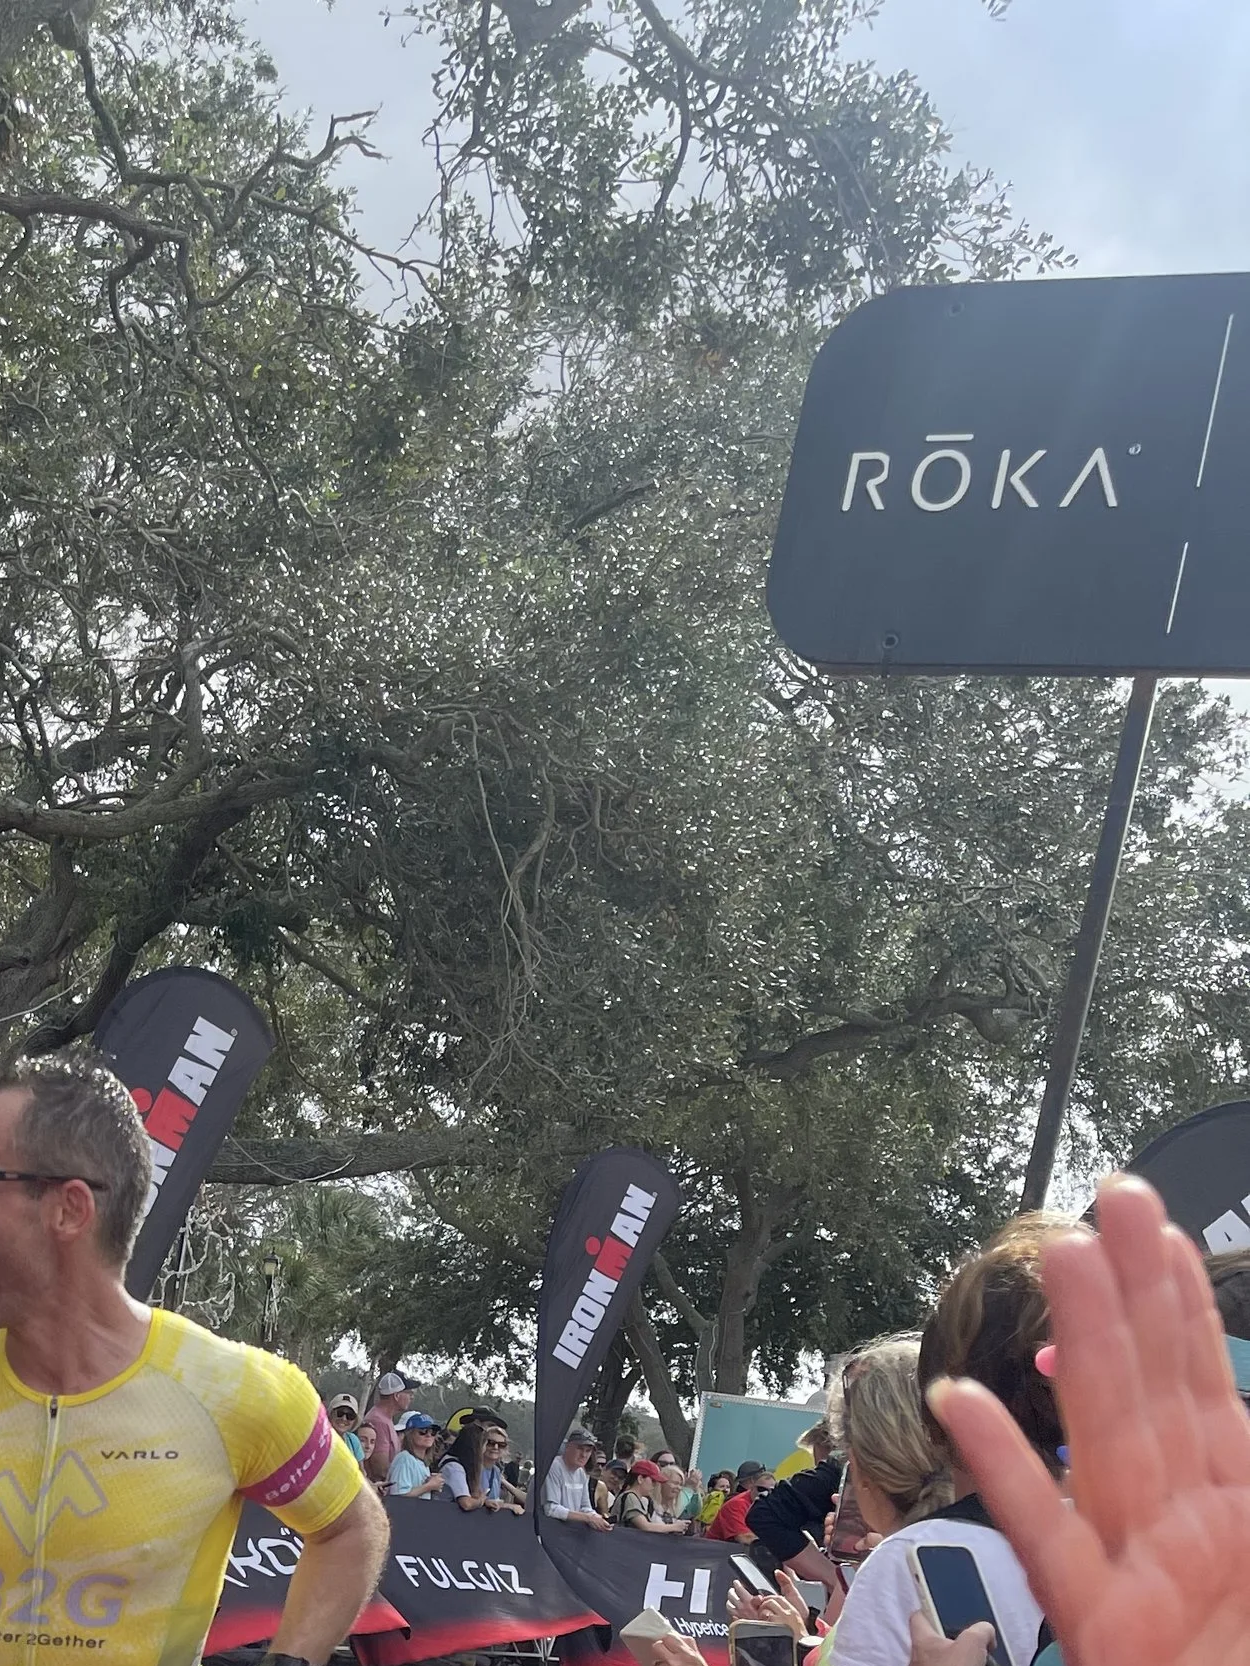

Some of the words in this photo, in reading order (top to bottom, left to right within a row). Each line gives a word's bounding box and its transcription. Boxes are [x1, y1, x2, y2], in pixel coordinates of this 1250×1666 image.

[552, 1183, 657, 1370] IRONMAN
[101, 1450, 179, 1460] VARLO
[395, 1555, 534, 1595] FULGAZ
[674, 1617, 729, 1638] Hyperice
